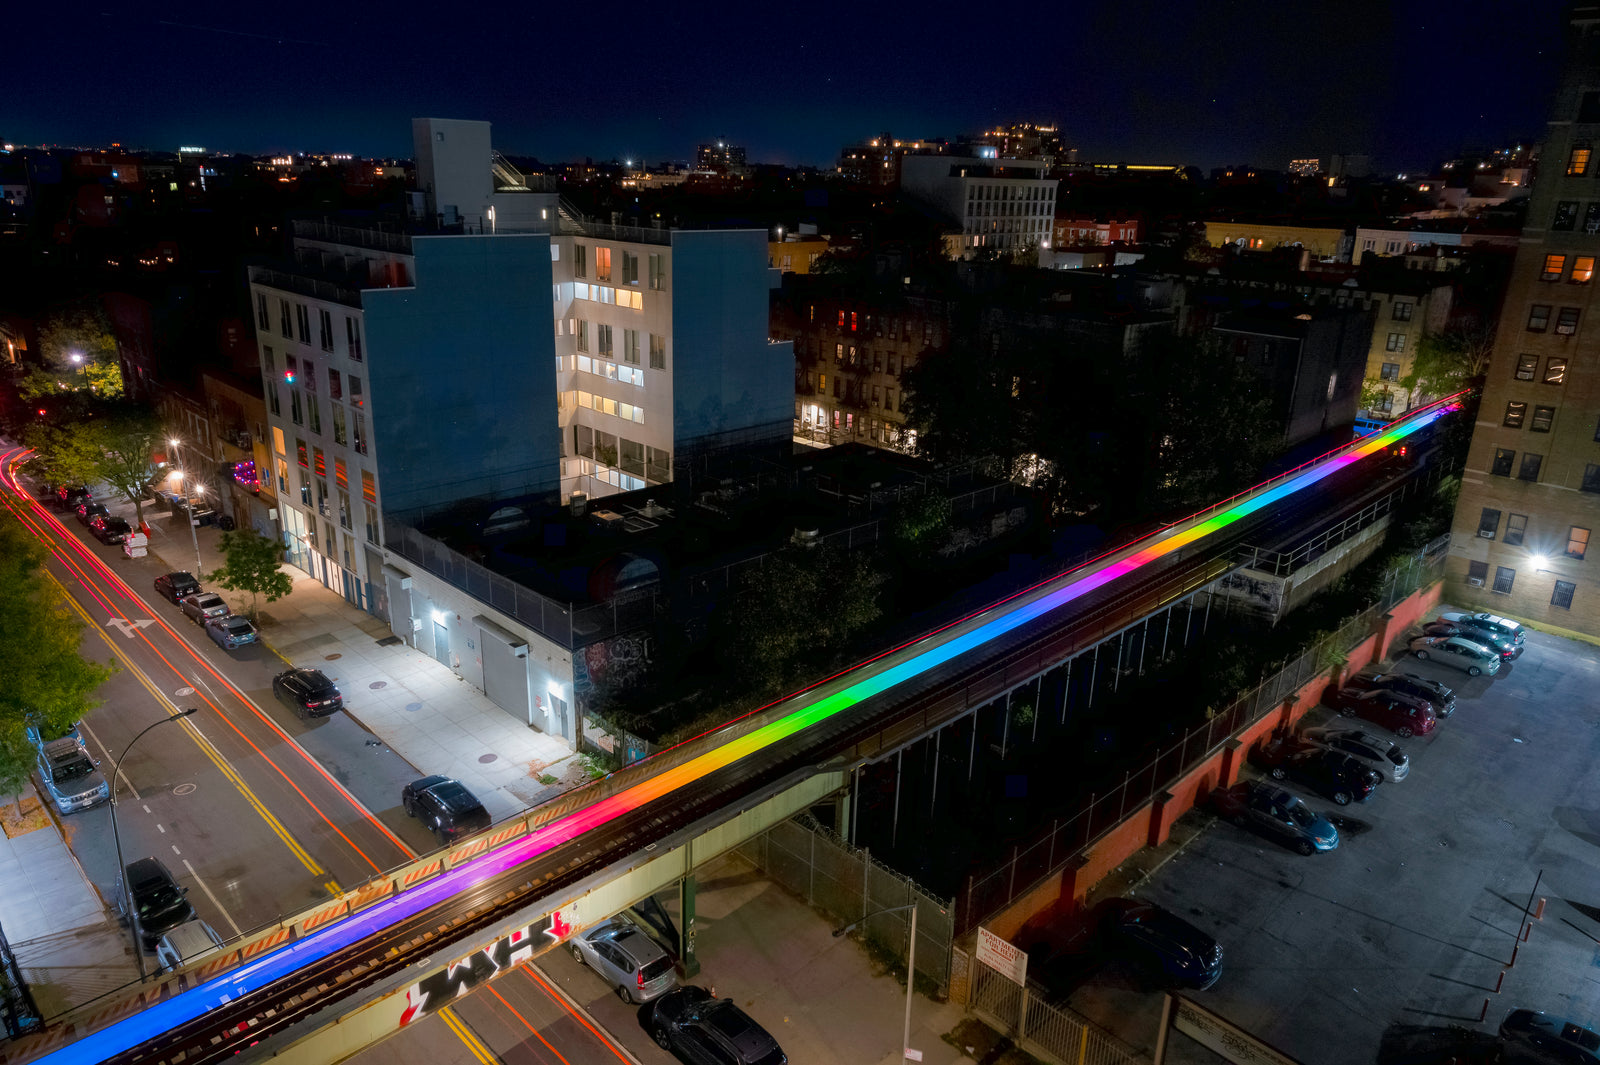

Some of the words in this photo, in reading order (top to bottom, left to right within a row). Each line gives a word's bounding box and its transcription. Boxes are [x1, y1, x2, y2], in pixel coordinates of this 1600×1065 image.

[980, 930, 1025, 960] APARTMENTS
[985, 938, 999, 950] FOR
[1000, 946, 1018, 961] RENT
